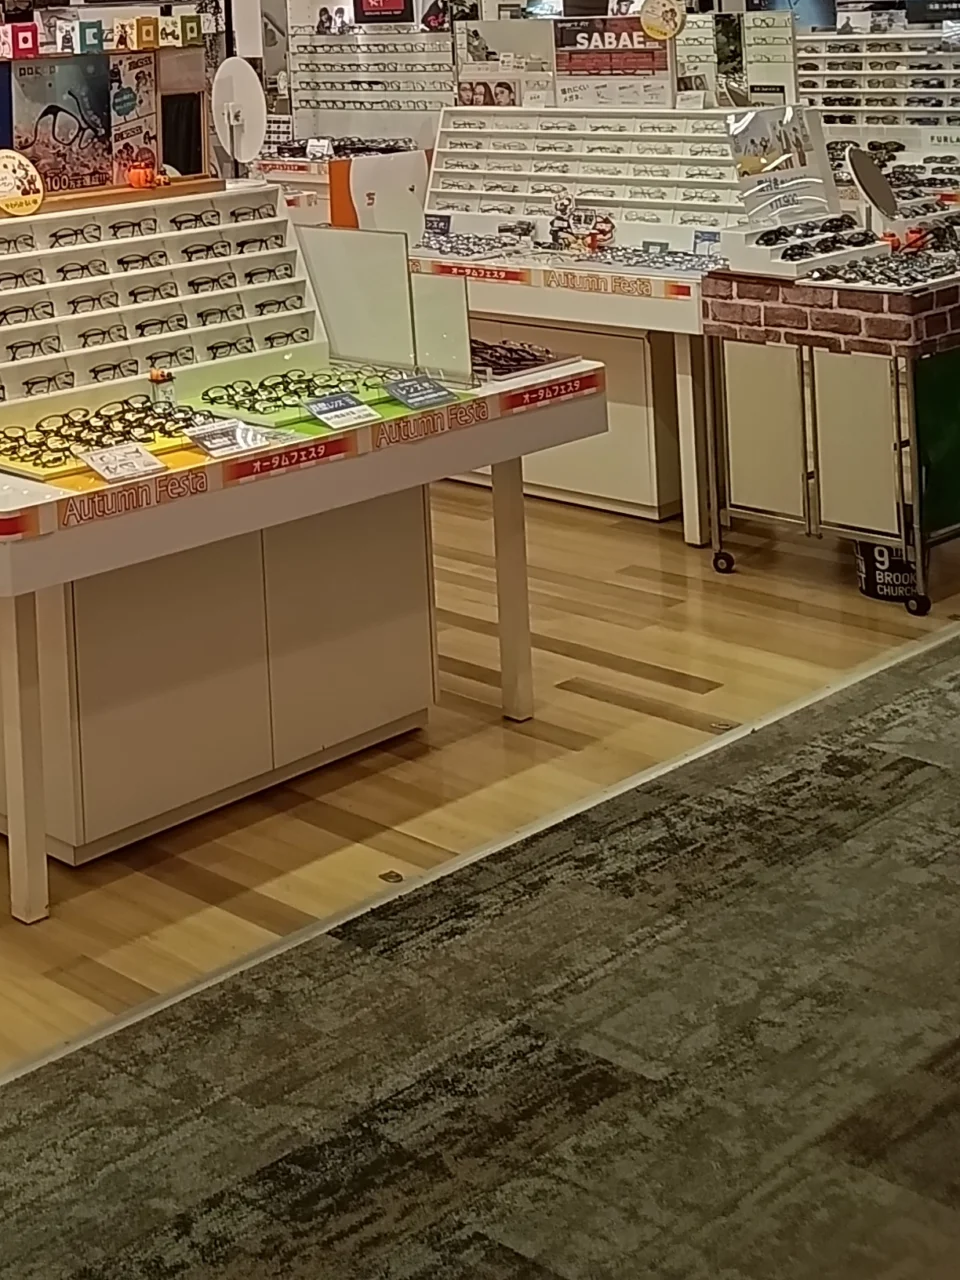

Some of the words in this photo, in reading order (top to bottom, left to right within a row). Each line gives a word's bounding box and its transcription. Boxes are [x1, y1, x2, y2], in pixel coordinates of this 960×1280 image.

[576, 32, 644, 49] SABAE
[452, 267, 506, 279] オータムフェスタ
[547, 271, 608, 293] Autumn
[611, 275, 652, 297] Festa
[523, 380, 580, 403] オータムフェスタ
[376, 411, 445, 448] Autumn
[447, 399, 490, 428] Festa
[252, 444, 325, 473] オータムフェスタ
[63, 483, 151, 526] Autumn
[155, 470, 208, 504] Festa
